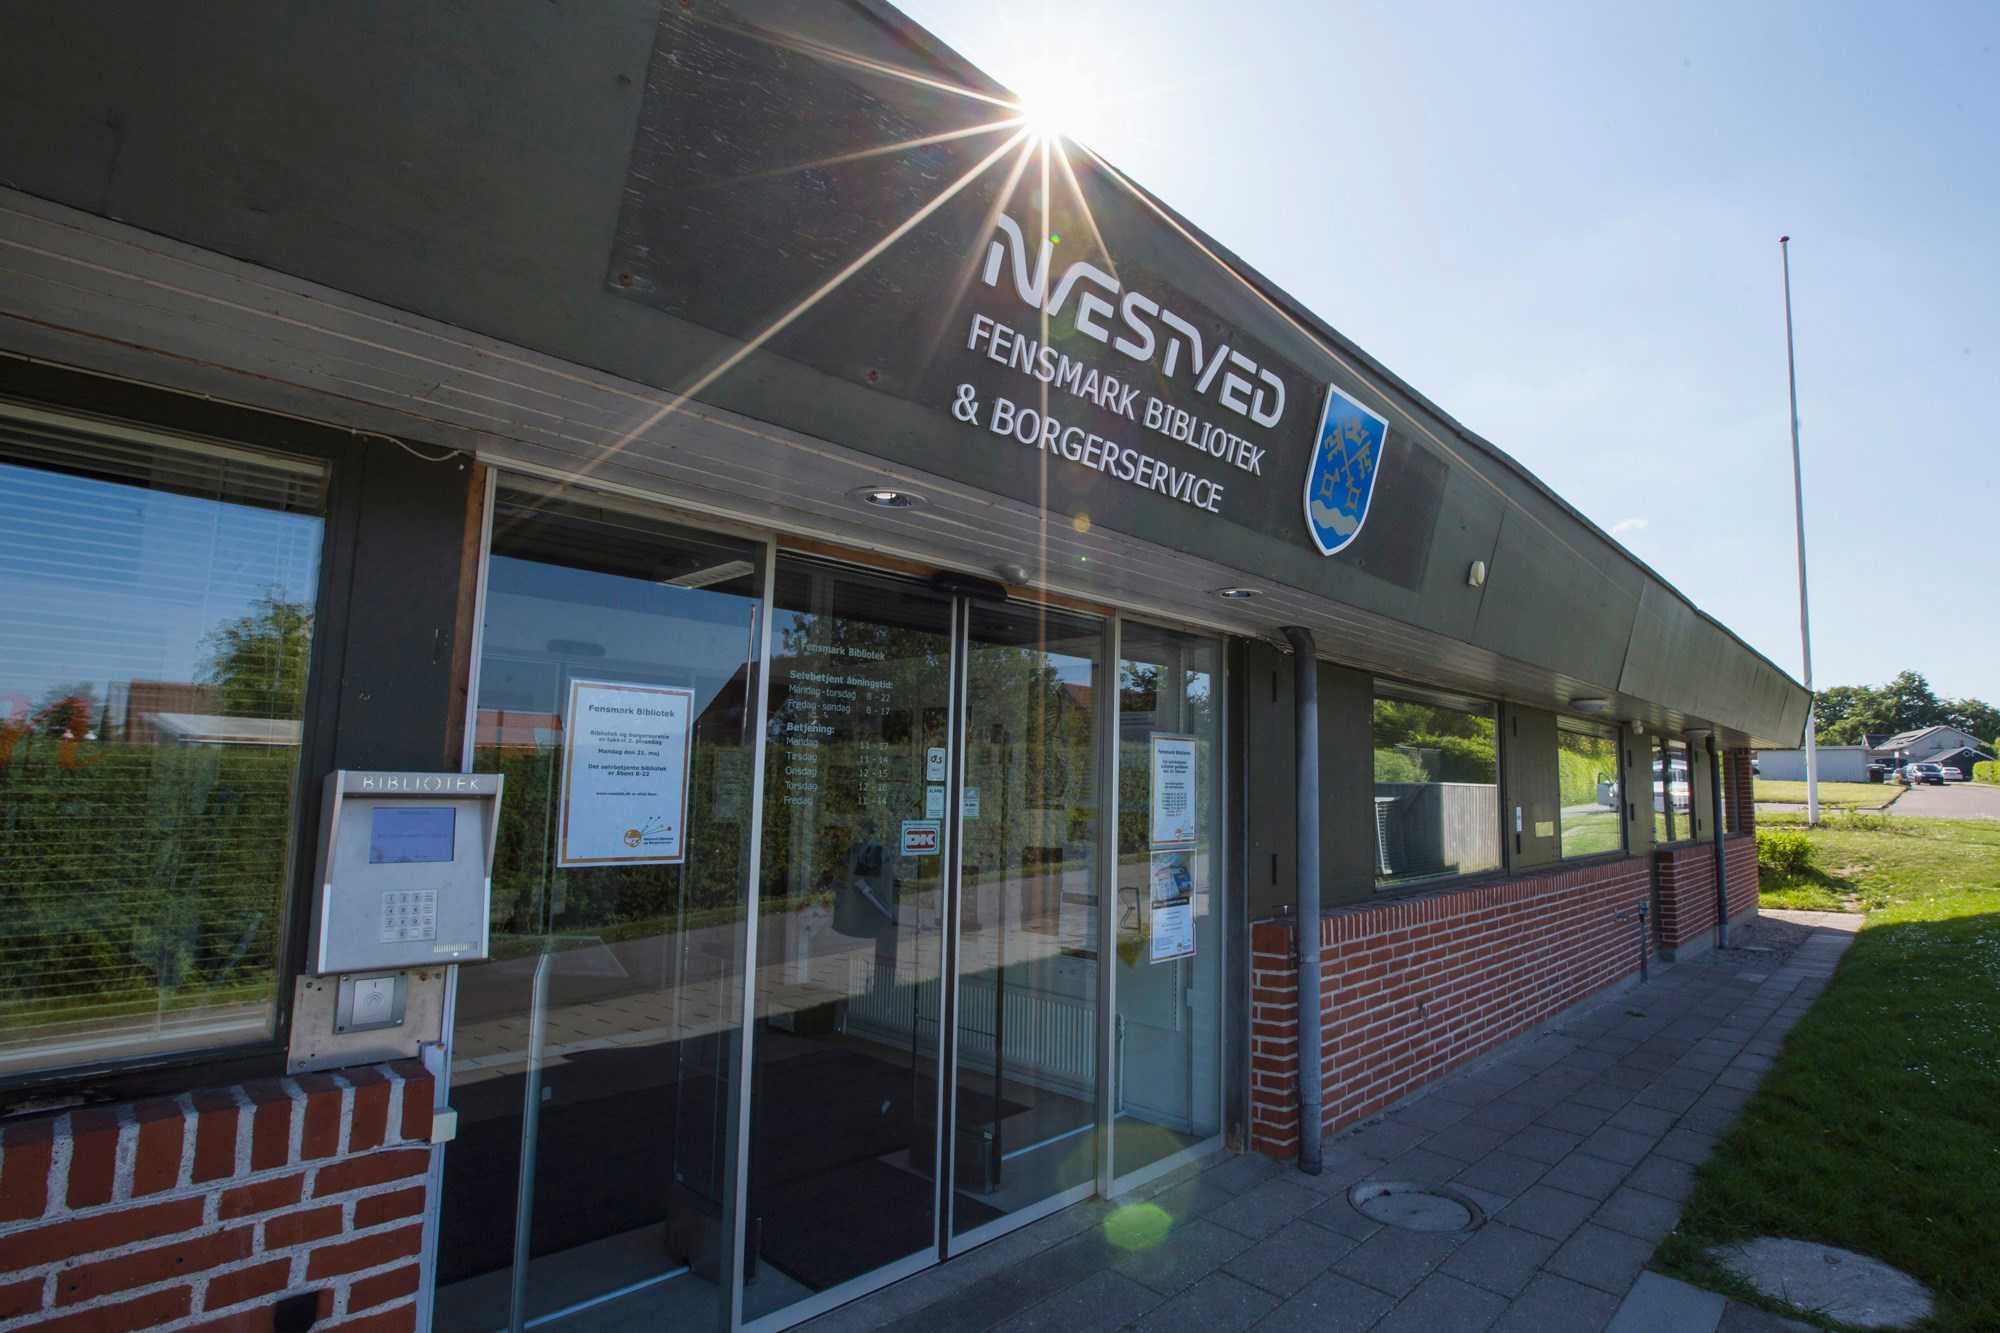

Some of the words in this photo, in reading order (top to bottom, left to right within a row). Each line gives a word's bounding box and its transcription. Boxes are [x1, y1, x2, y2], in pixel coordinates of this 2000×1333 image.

[967, 312, 1140, 421] FENSMARK
[1142, 396, 1266, 477] BIBLIOTEK
[952, 383, 979, 426] &
[990, 397, 1225, 514] BORGERSERVICE
[800, 642, 845, 656] Fensmark
[848, 647, 886, 660] Bibliotek
[588, 704, 634, 715] Fensmark
[636, 706, 675, 717] Bibliotek
[362, 776, 480, 791] BIBLIOTEK
